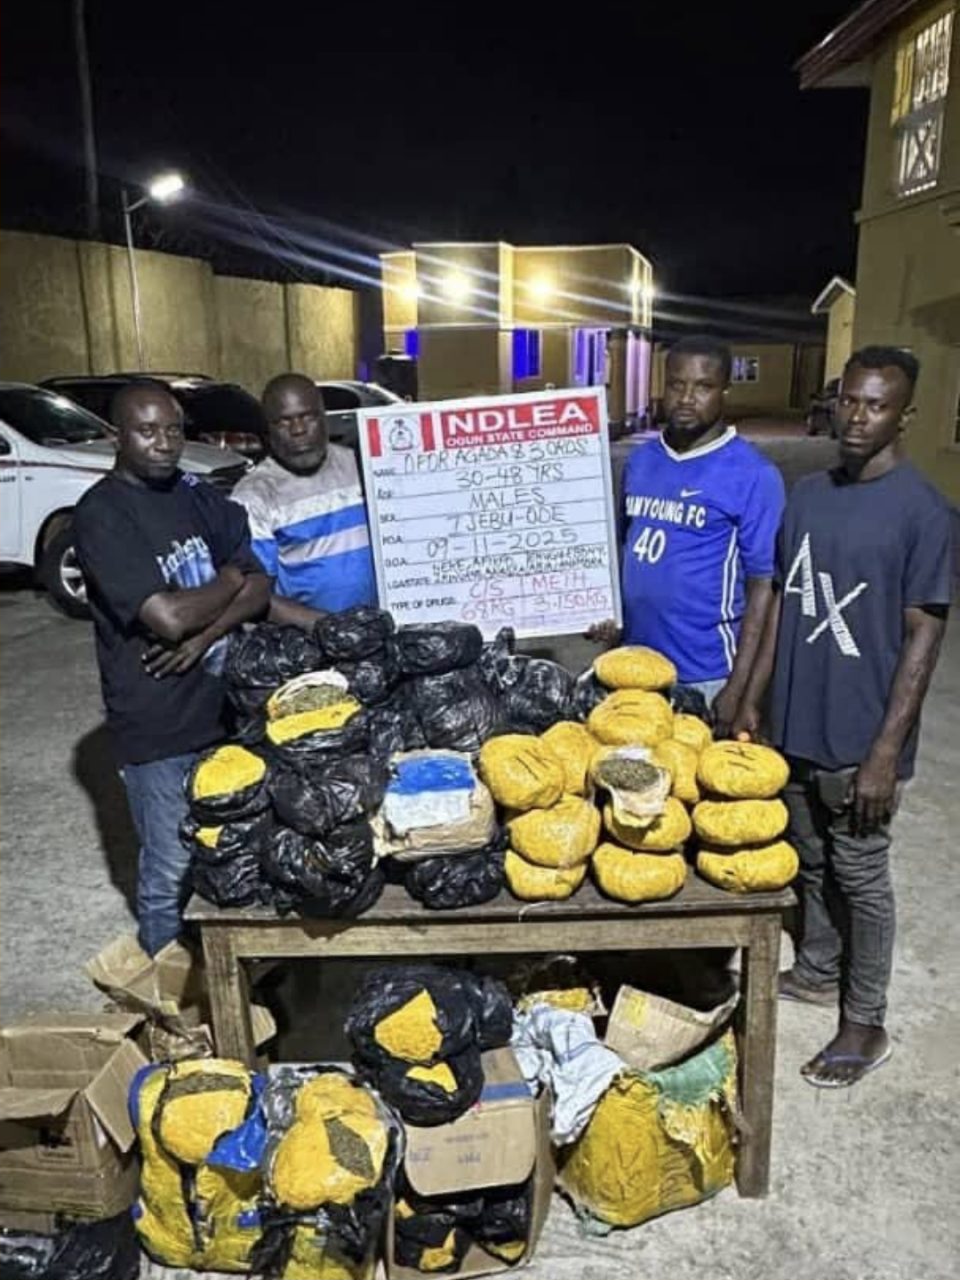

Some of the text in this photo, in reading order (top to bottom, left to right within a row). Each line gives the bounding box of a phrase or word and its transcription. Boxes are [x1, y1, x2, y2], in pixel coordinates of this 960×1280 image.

[447, 402, 589, 435] NDLEA
[446, 423, 593, 447] OGUN STATE COMMAND
[529, 462, 564, 482] YRS
[469, 487, 545, 511] MALES
[686, 504, 707, 528] FC
[632, 527, 666, 564] 40
[531, 572, 586, 592] METH
[785, 532, 868, 658] AX
